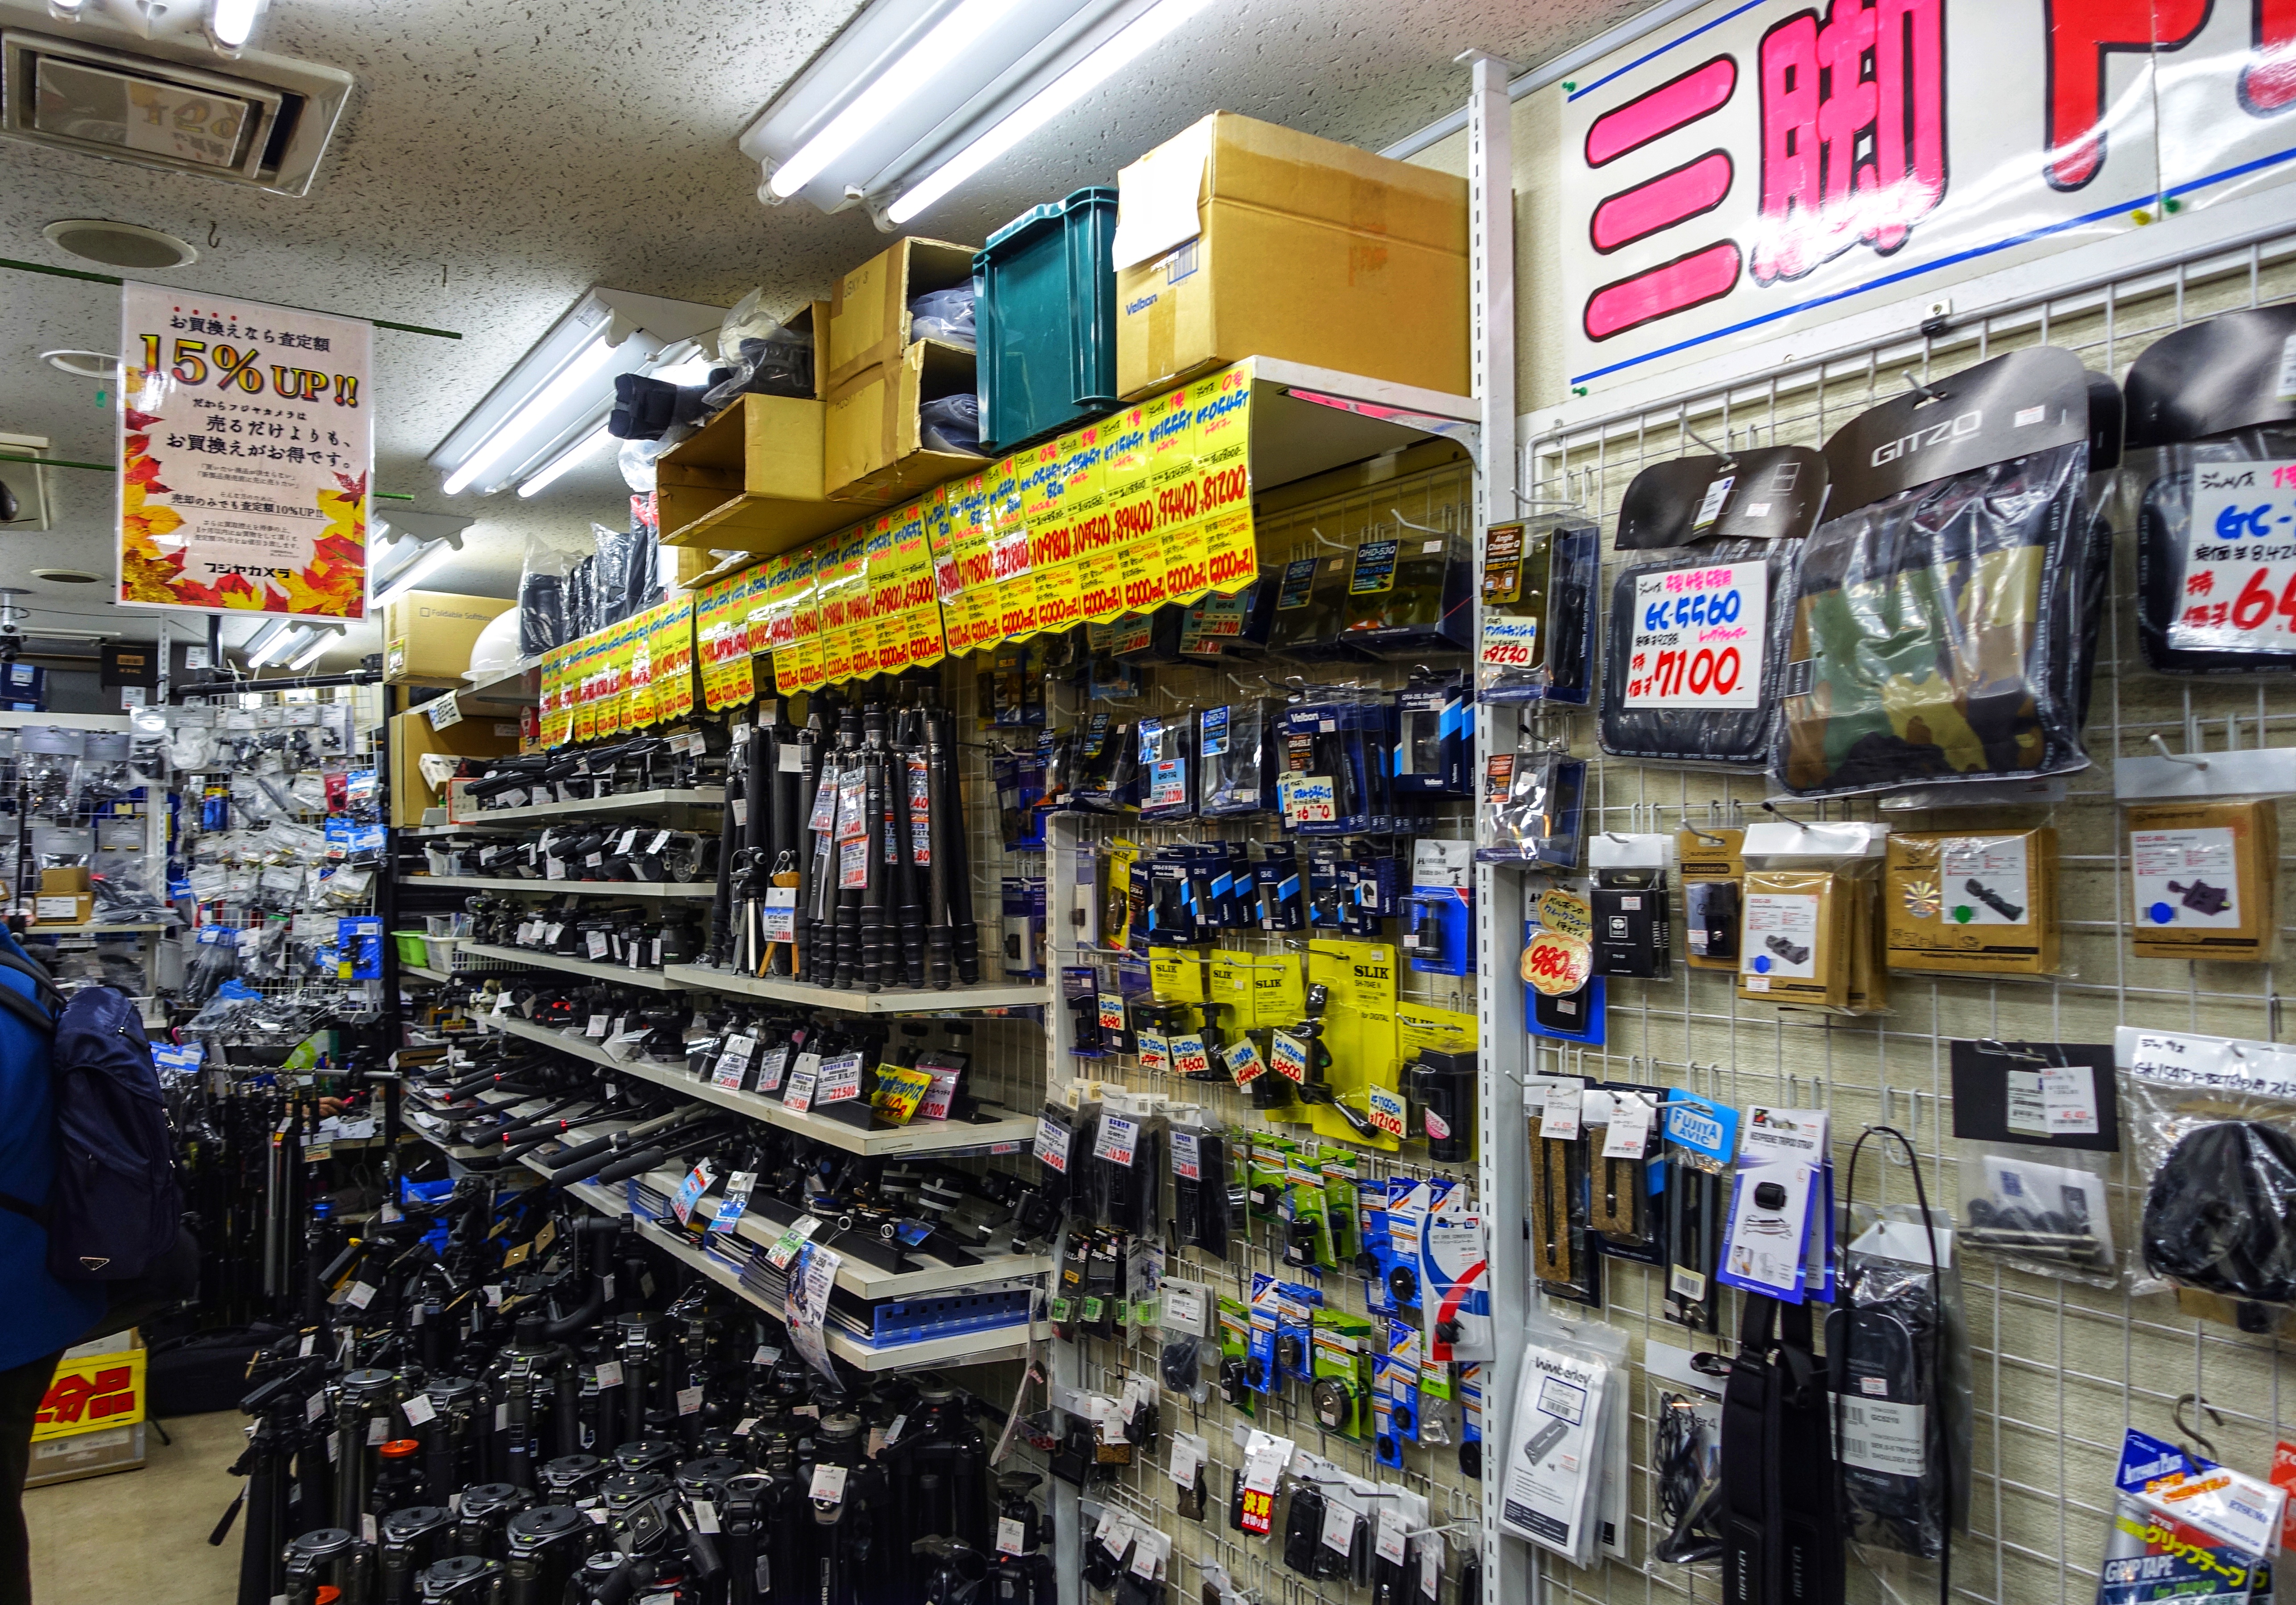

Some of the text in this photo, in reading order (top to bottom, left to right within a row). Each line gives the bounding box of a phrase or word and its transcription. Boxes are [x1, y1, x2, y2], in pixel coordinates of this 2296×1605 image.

[1126, 294, 1157, 316] Velbon
[170, 314, 330, 352] お買換えなら査定額
[193, 398, 307, 420] だからフジヤカメラは
[206, 415, 352, 447] 売るだけよりも、
[1871, 410, 1982, 468] GITZO
[166, 432, 353, 470] お買換えがお得です。
[1494, 535, 1515, 543] Angle
[204, 562, 291, 579] フジヤカメラ
[431, 609, 463, 619] Foldable
[1290, 713, 1320, 723] Velbon
[1114, 851, 1128, 861] SLIK
[1684, 865, 1729, 873] Accessories
[1155, 964, 1177, 973] SLIK
[1213, 970, 1233, 979] SLIK
[1353, 965, 1389, 980] SLIK
[1255, 979, 1282, 989] SLIK
[1369, 1013, 1389, 1022] DIGITAL
[1673, 1109, 1718, 1140] FUJIYA
[1678, 1127, 1711, 1146] AVIC
[1749, 1131, 1815, 1151] NEOPRENE TRIPOD STRAP
[1534, 1356, 1592, 1388] wimberley
[1242, 1490, 1272, 1518] 決算
[1241, 1512, 1269, 1530] 見切り品
[2145, 1524, 2248, 1587] グリップテープ
[2104, 1554, 2175, 1583] GRIP TAPE
